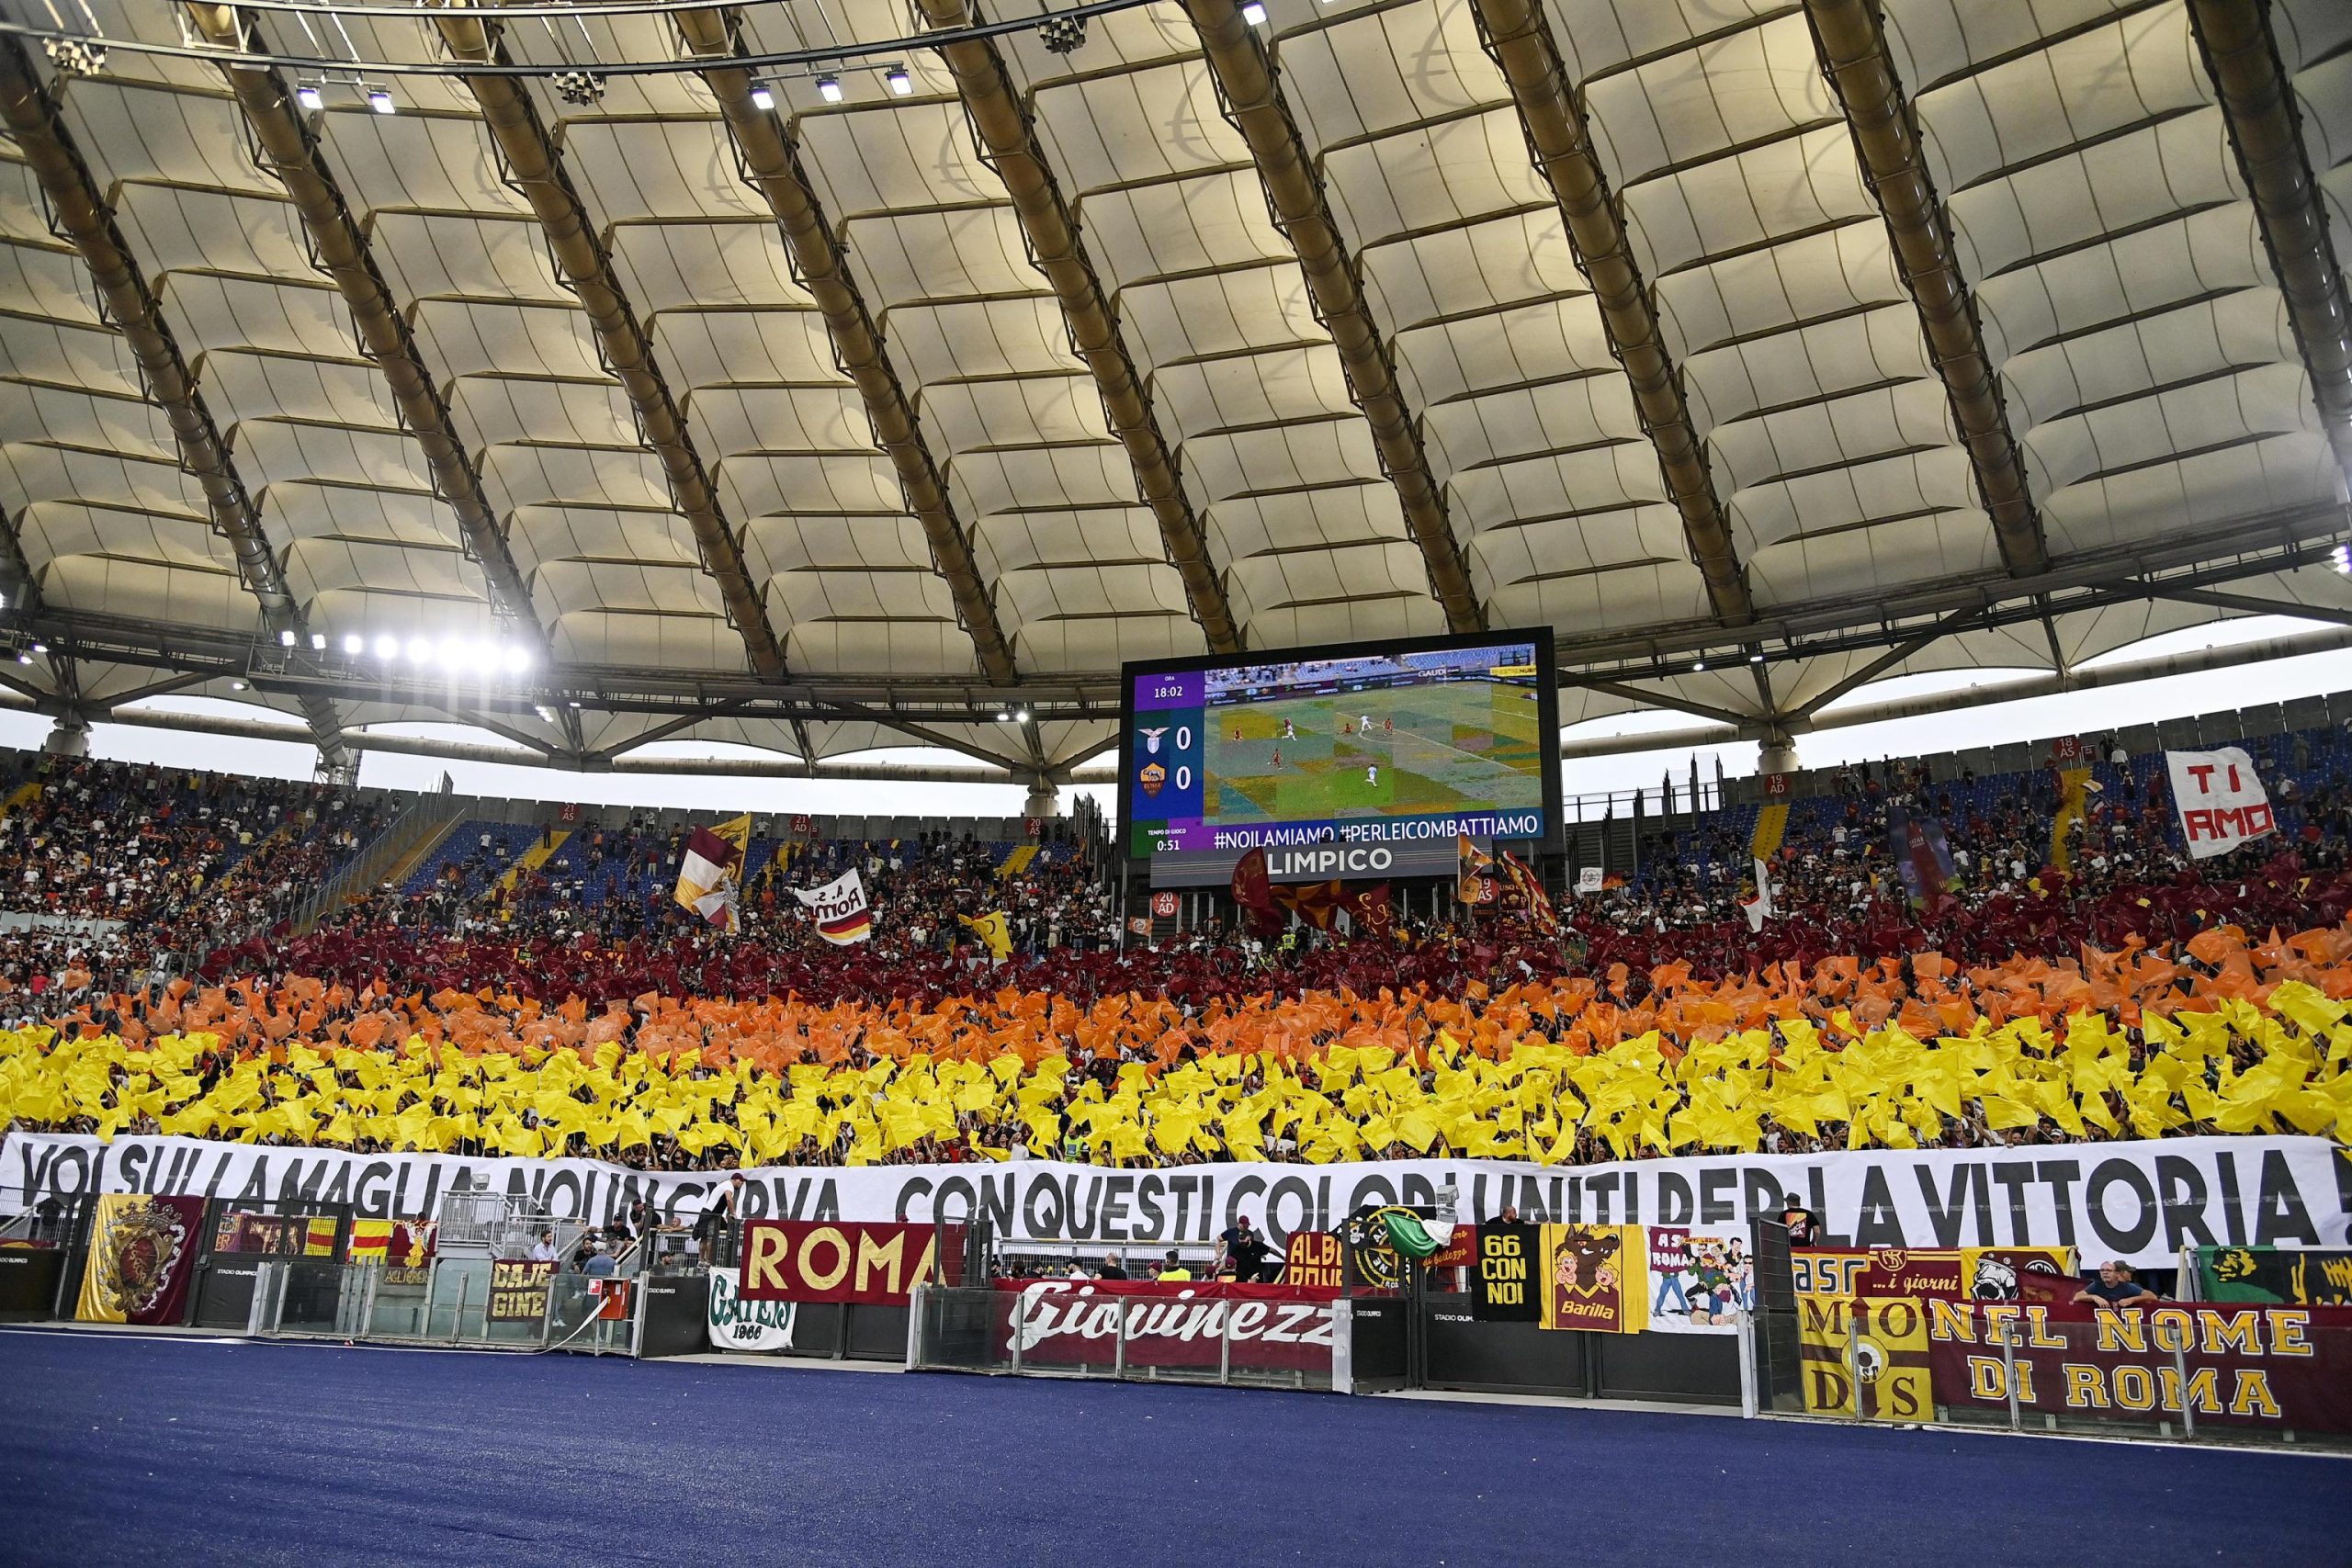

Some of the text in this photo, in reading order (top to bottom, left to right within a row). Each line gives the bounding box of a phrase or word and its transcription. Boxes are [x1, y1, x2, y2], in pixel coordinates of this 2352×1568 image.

[1154, 685, 1182, 698] 18:02
[1176, 726, 1192, 750] 0
[2059, 737, 2073, 748] 18
[2060, 746, 2075, 758] AS
[1176, 765, 1192, 790] 0
[1770, 774, 1782, 784] 19
[2187, 763, 2242, 795] TI
[1770, 784, 1785, 795] AD
[561, 812, 574, 821] AS
[796, 815, 806, 824] 21
[1030, 818, 1041, 827] 20
[2183, 802, 2275, 841] AMO
[793, 823, 807, 832] AD
[1029, 827, 1041, 835] AS
[1213, 815, 1539, 850] #NOILAMIAMO #PERLEICOMBATTIAMO
[1157, 840, 1181, 852] 0:51
[1268, 848, 1393, 875] LIMPICO
[1159, 891, 1173, 903] 20
[1477, 889, 1493, 901] AS
[1158, 902, 1175, 914] AD
[895, 1172, 1016, 1239] CON
[1023, 1171, 1214, 1242] QUESTI
[1472, 1170, 1639, 1225] UNITI
[1807, 1165, 1908, 1248] LA
[1912, 1148, 2323, 1255] VITTORIA
[1485, 1235, 1521, 1257] 66
[1657, 1233, 1681, 1248] AS
[747, 1225, 948, 1294] ROMA
[1481, 1258, 1527, 1280] CON
[1651, 1252, 1690, 1267] ROMA
[492, 1263, 552, 1289] DAJE
[1903, 1274, 1959, 1293] giorni
[1487, 1282, 1524, 1304] NOI
[492, 1292, 548, 1317] GINE
[1560, 1300, 1615, 1321] Barilla
[1005, 1281, 1334, 1352] Giovinezz
[1434, 1314, 1456, 1322] STADIO
[1929, 1298, 2314, 1357] NEL NOME
[1966, 1355, 2282, 1418] DI ROMA
